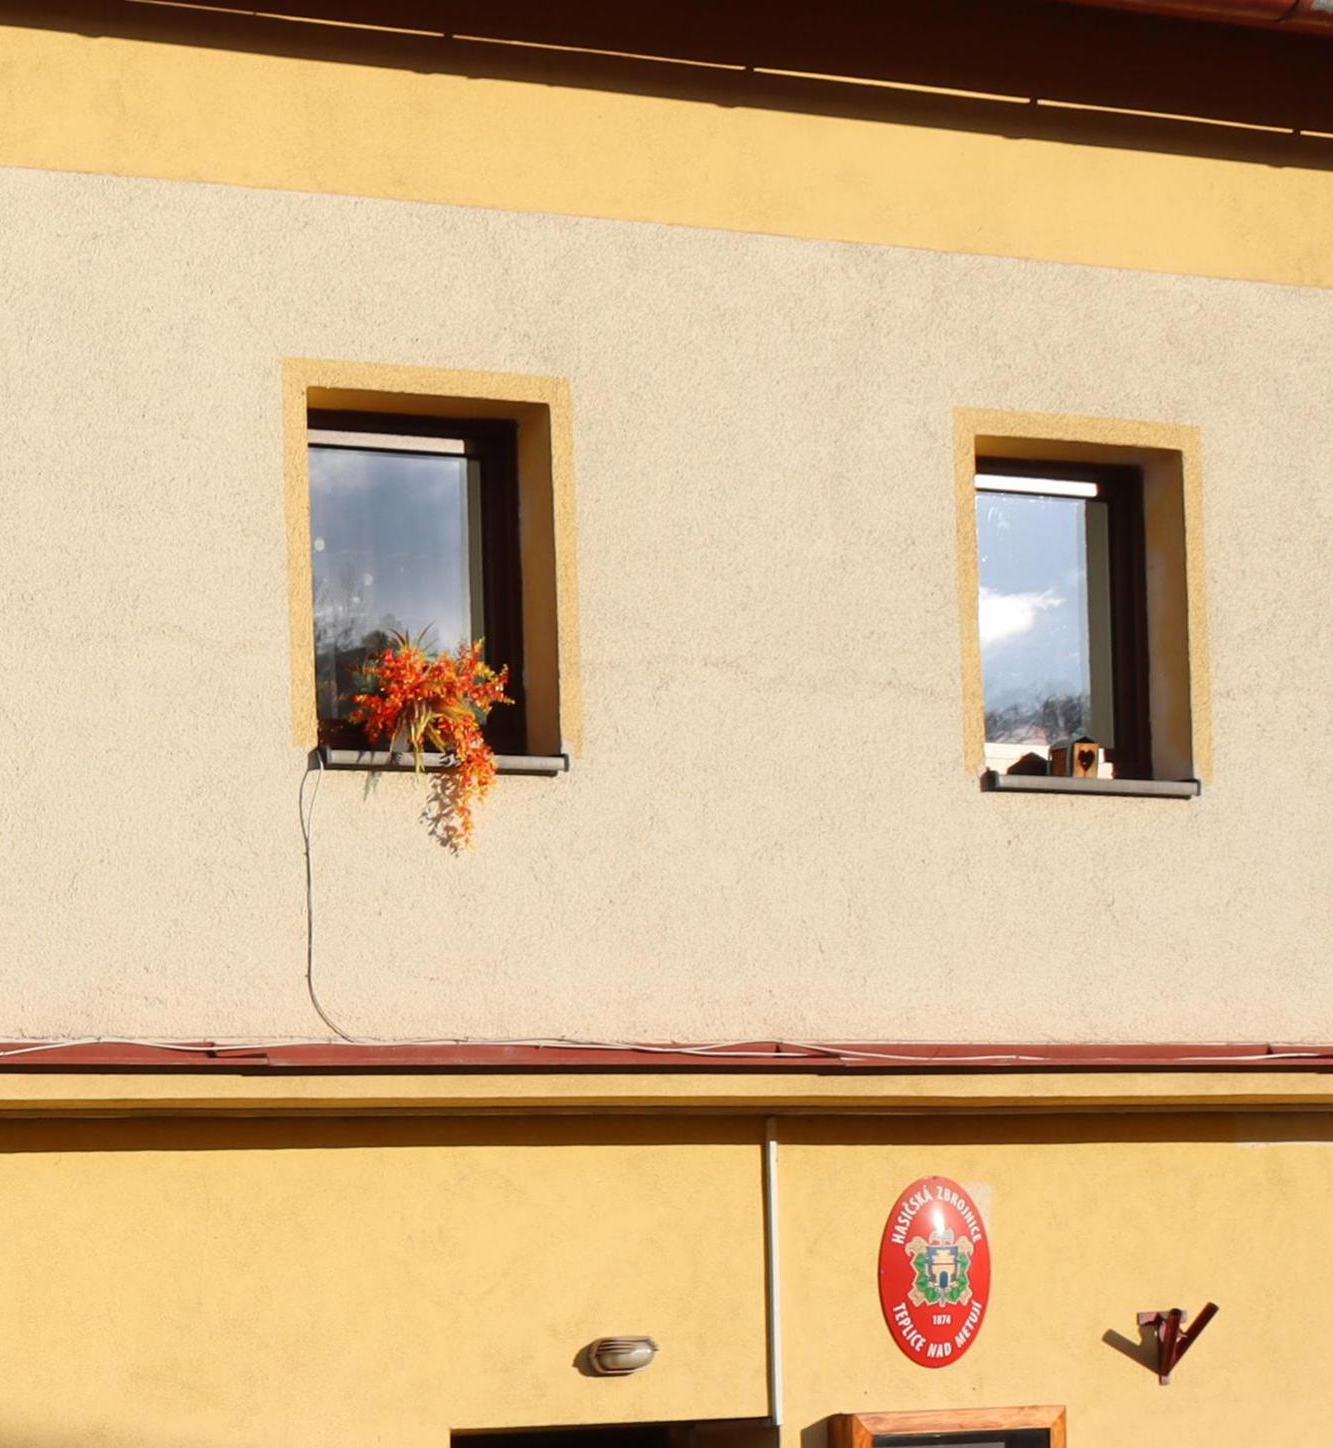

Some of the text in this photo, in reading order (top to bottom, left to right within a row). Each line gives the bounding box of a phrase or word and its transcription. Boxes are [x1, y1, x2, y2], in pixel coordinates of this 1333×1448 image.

[891, 1184, 982, 1245] HASIČSKÁ ZBROJNICE
[893, 1300, 982, 1357] TEPLICE NAD METUJÍ
[932, 1314, 951, 1325] 1874
